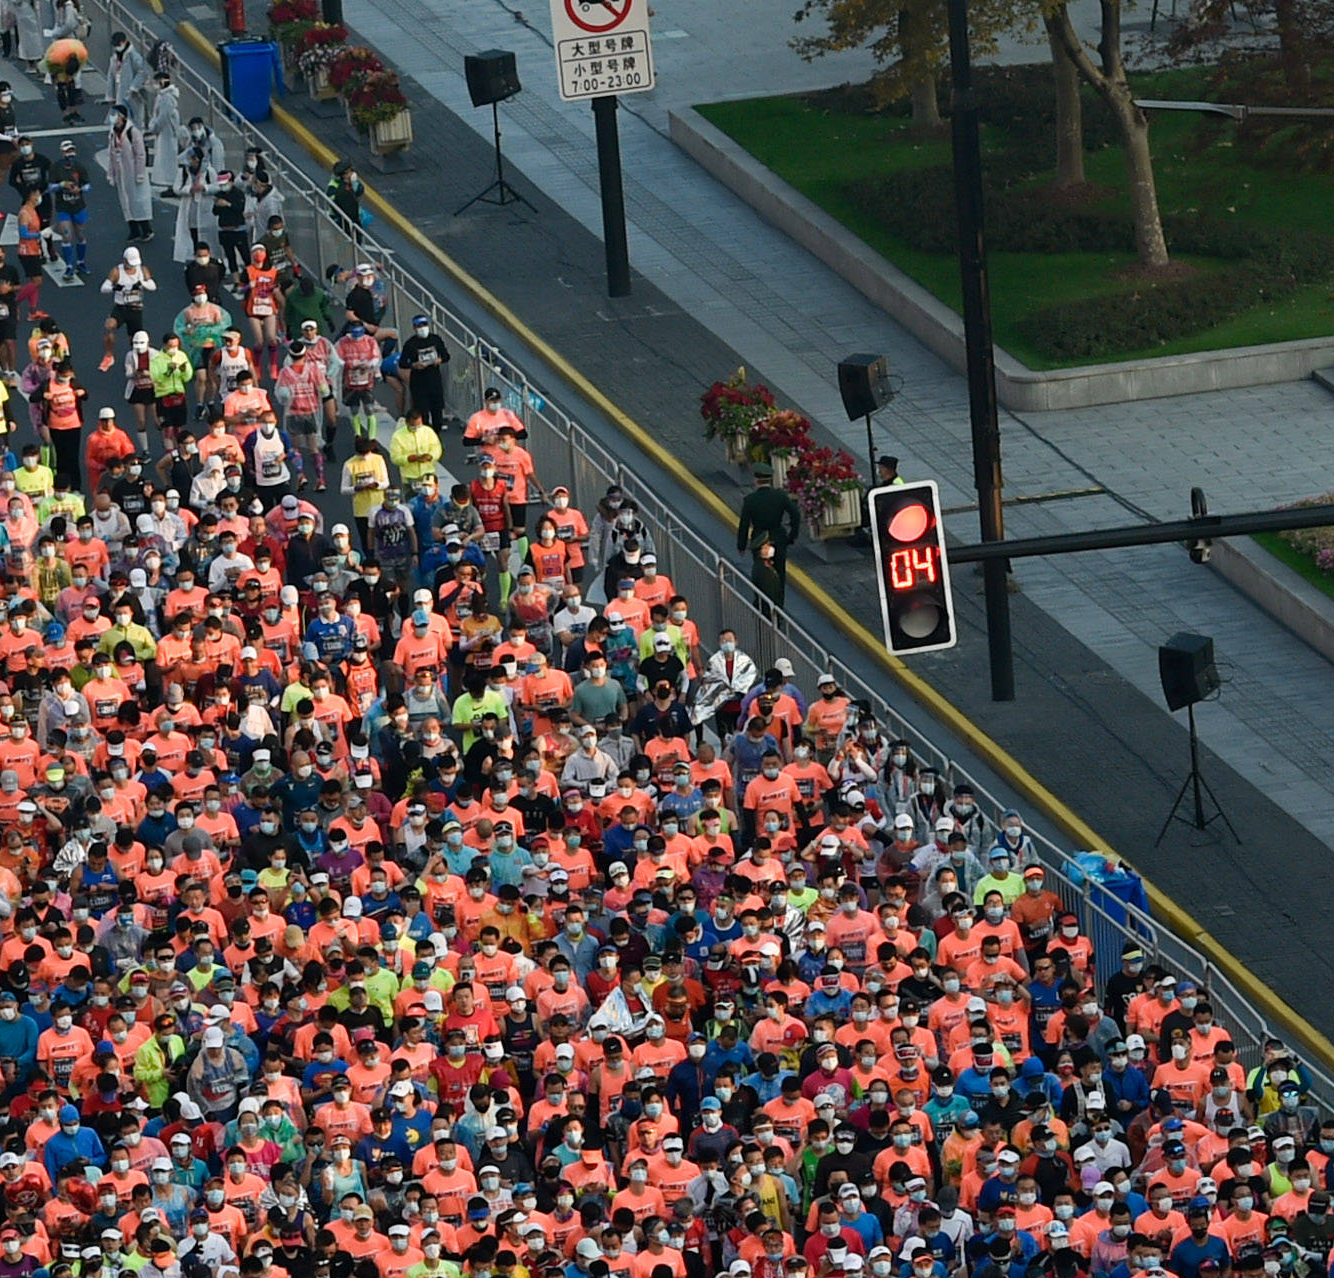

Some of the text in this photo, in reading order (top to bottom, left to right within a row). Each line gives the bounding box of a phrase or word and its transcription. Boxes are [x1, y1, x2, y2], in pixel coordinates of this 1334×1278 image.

[571, 37, 635, 57] 大型号牌
[573, 57, 636, 77] 小型号牌
[571, 72, 641, 93] 7:00-23:00
[891, 547, 935, 589] 04
